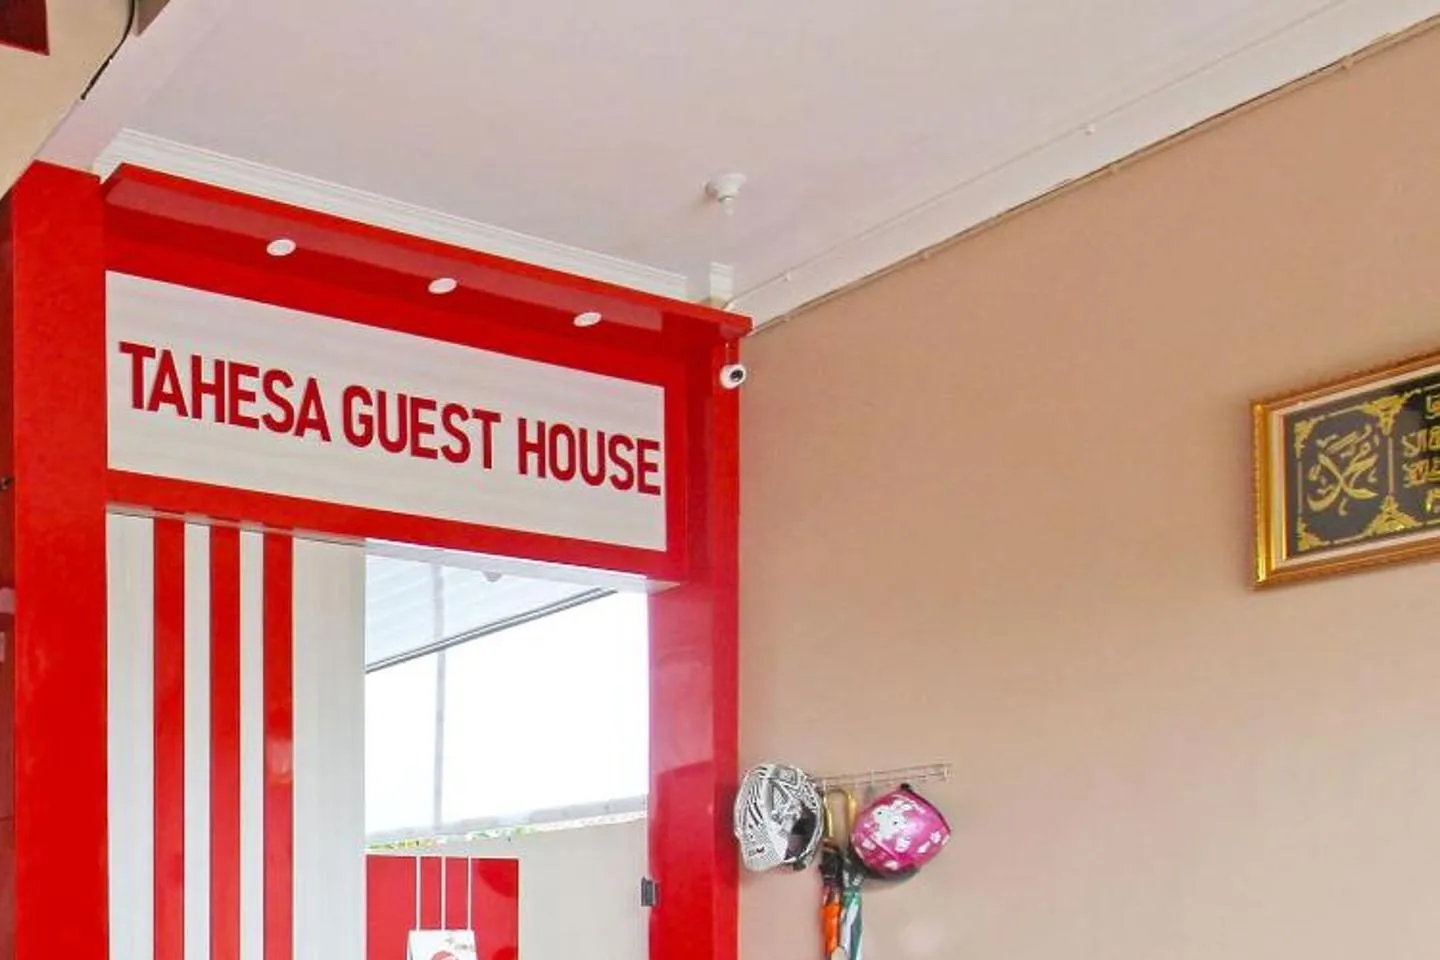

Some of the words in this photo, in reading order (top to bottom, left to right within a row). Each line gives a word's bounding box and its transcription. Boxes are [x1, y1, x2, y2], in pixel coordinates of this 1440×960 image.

[119, 340, 331, 443] TAHESA
[341, 384, 502, 470] GUEST
[517, 417, 661, 496] HOUSE
